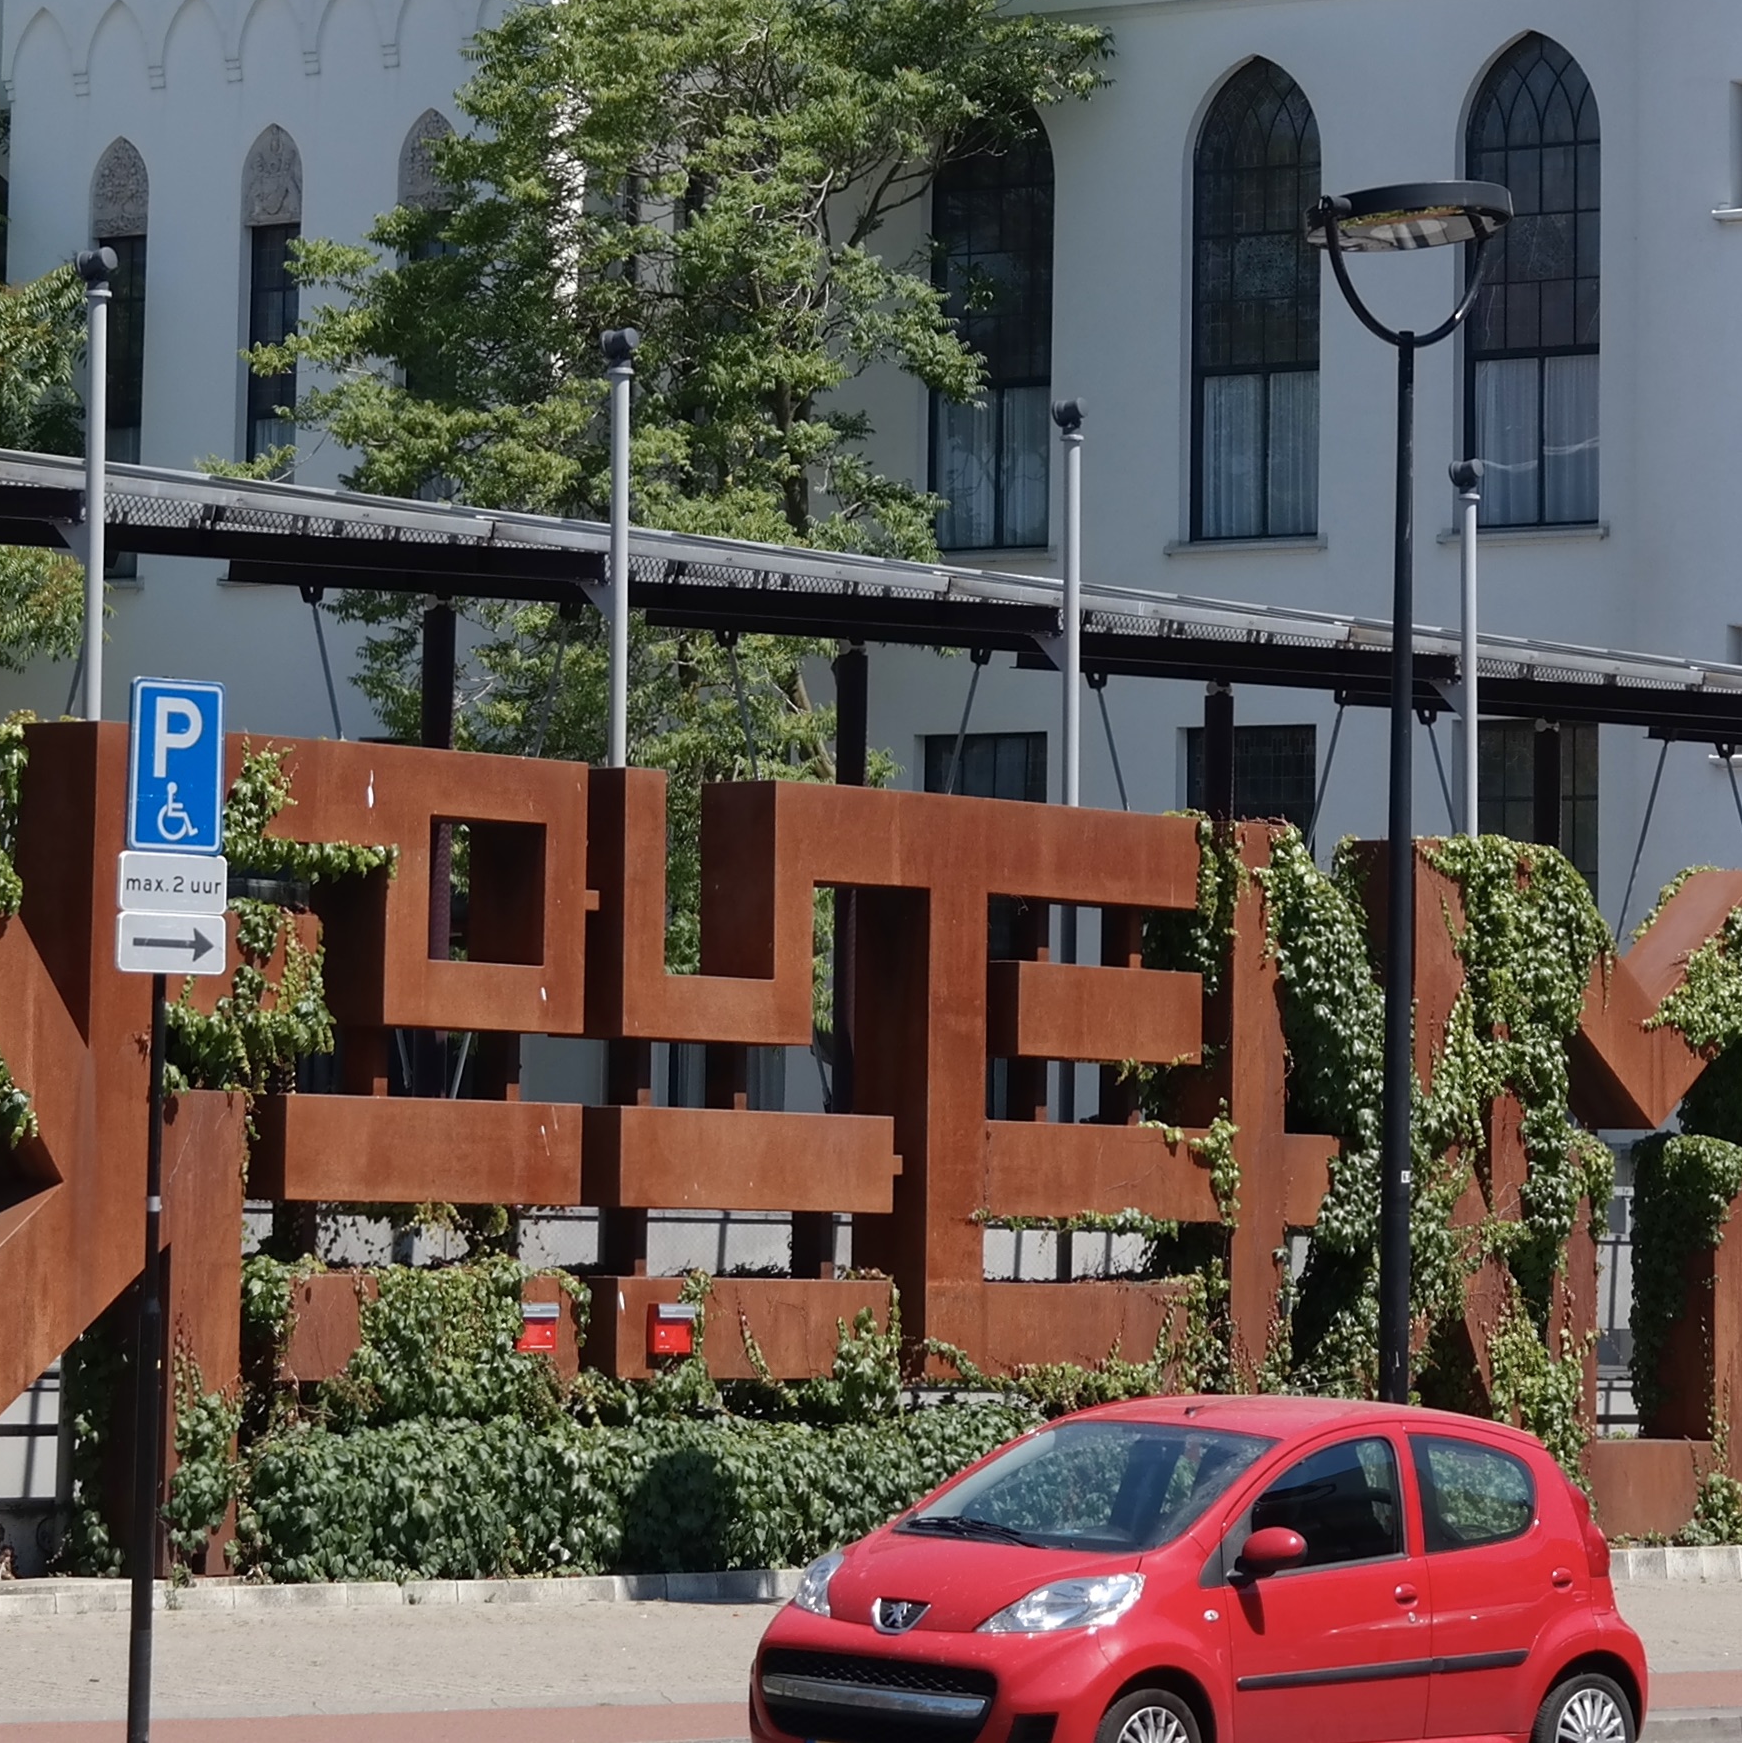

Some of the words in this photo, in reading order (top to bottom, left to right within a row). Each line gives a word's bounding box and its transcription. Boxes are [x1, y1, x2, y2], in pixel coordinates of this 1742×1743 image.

[153, 695, 203, 778] P
[126, 876, 169, 893] max.
[173, 875, 185, 894] 2
[190, 878, 222, 895] uur
